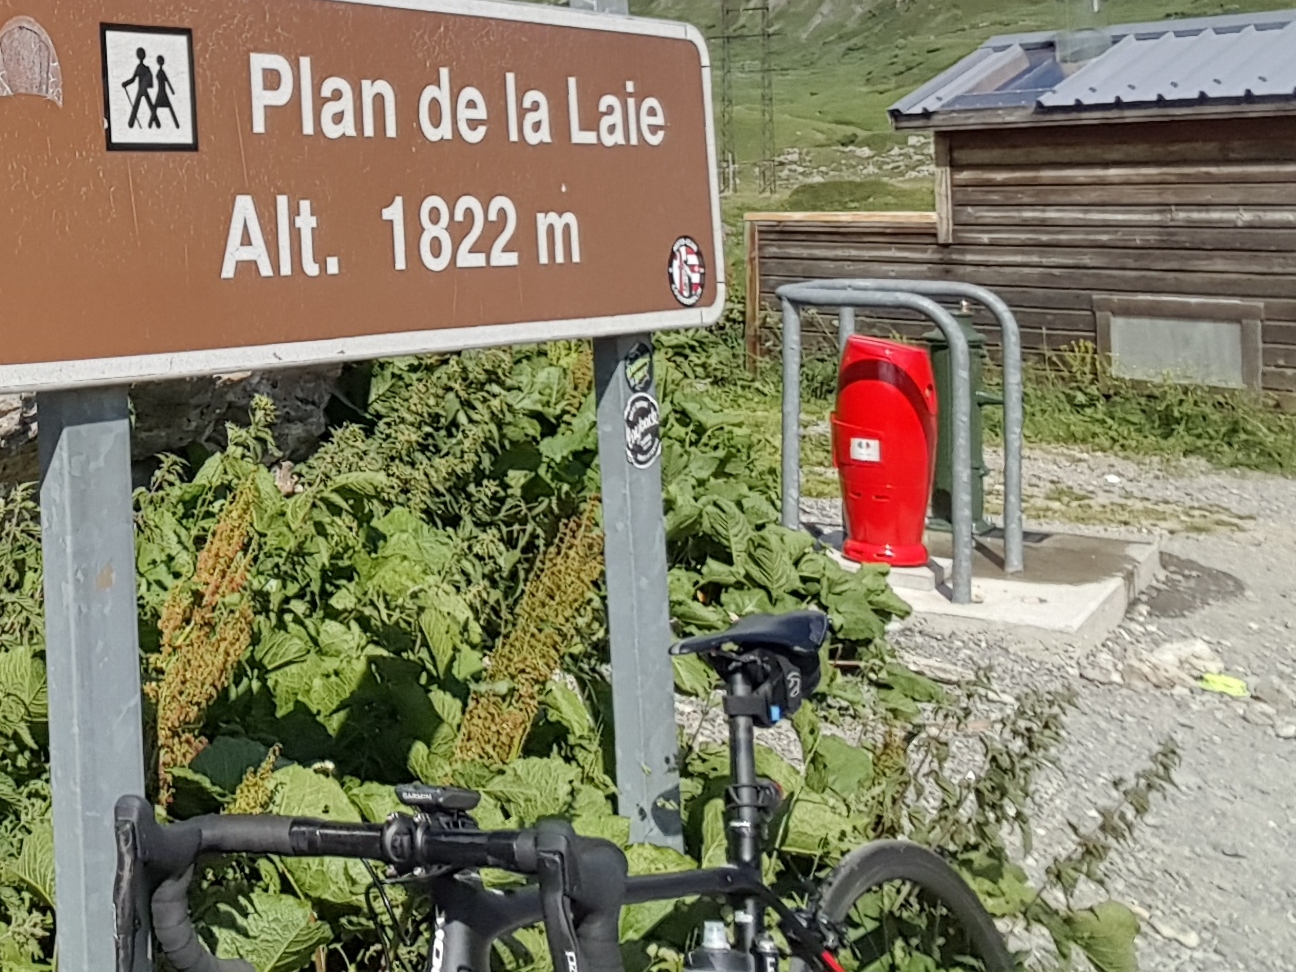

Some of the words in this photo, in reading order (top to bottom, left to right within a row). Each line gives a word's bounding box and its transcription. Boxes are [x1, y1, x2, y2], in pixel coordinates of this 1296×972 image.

[249, 52, 397, 139] Plan
[418, 66, 488, 144] de
[505, 71, 552, 146] la
[567, 76, 666, 147] Laie
[220, 194, 340, 279] Alt.
[381, 194, 519, 272] 1822
[535, 210, 580, 264] m
